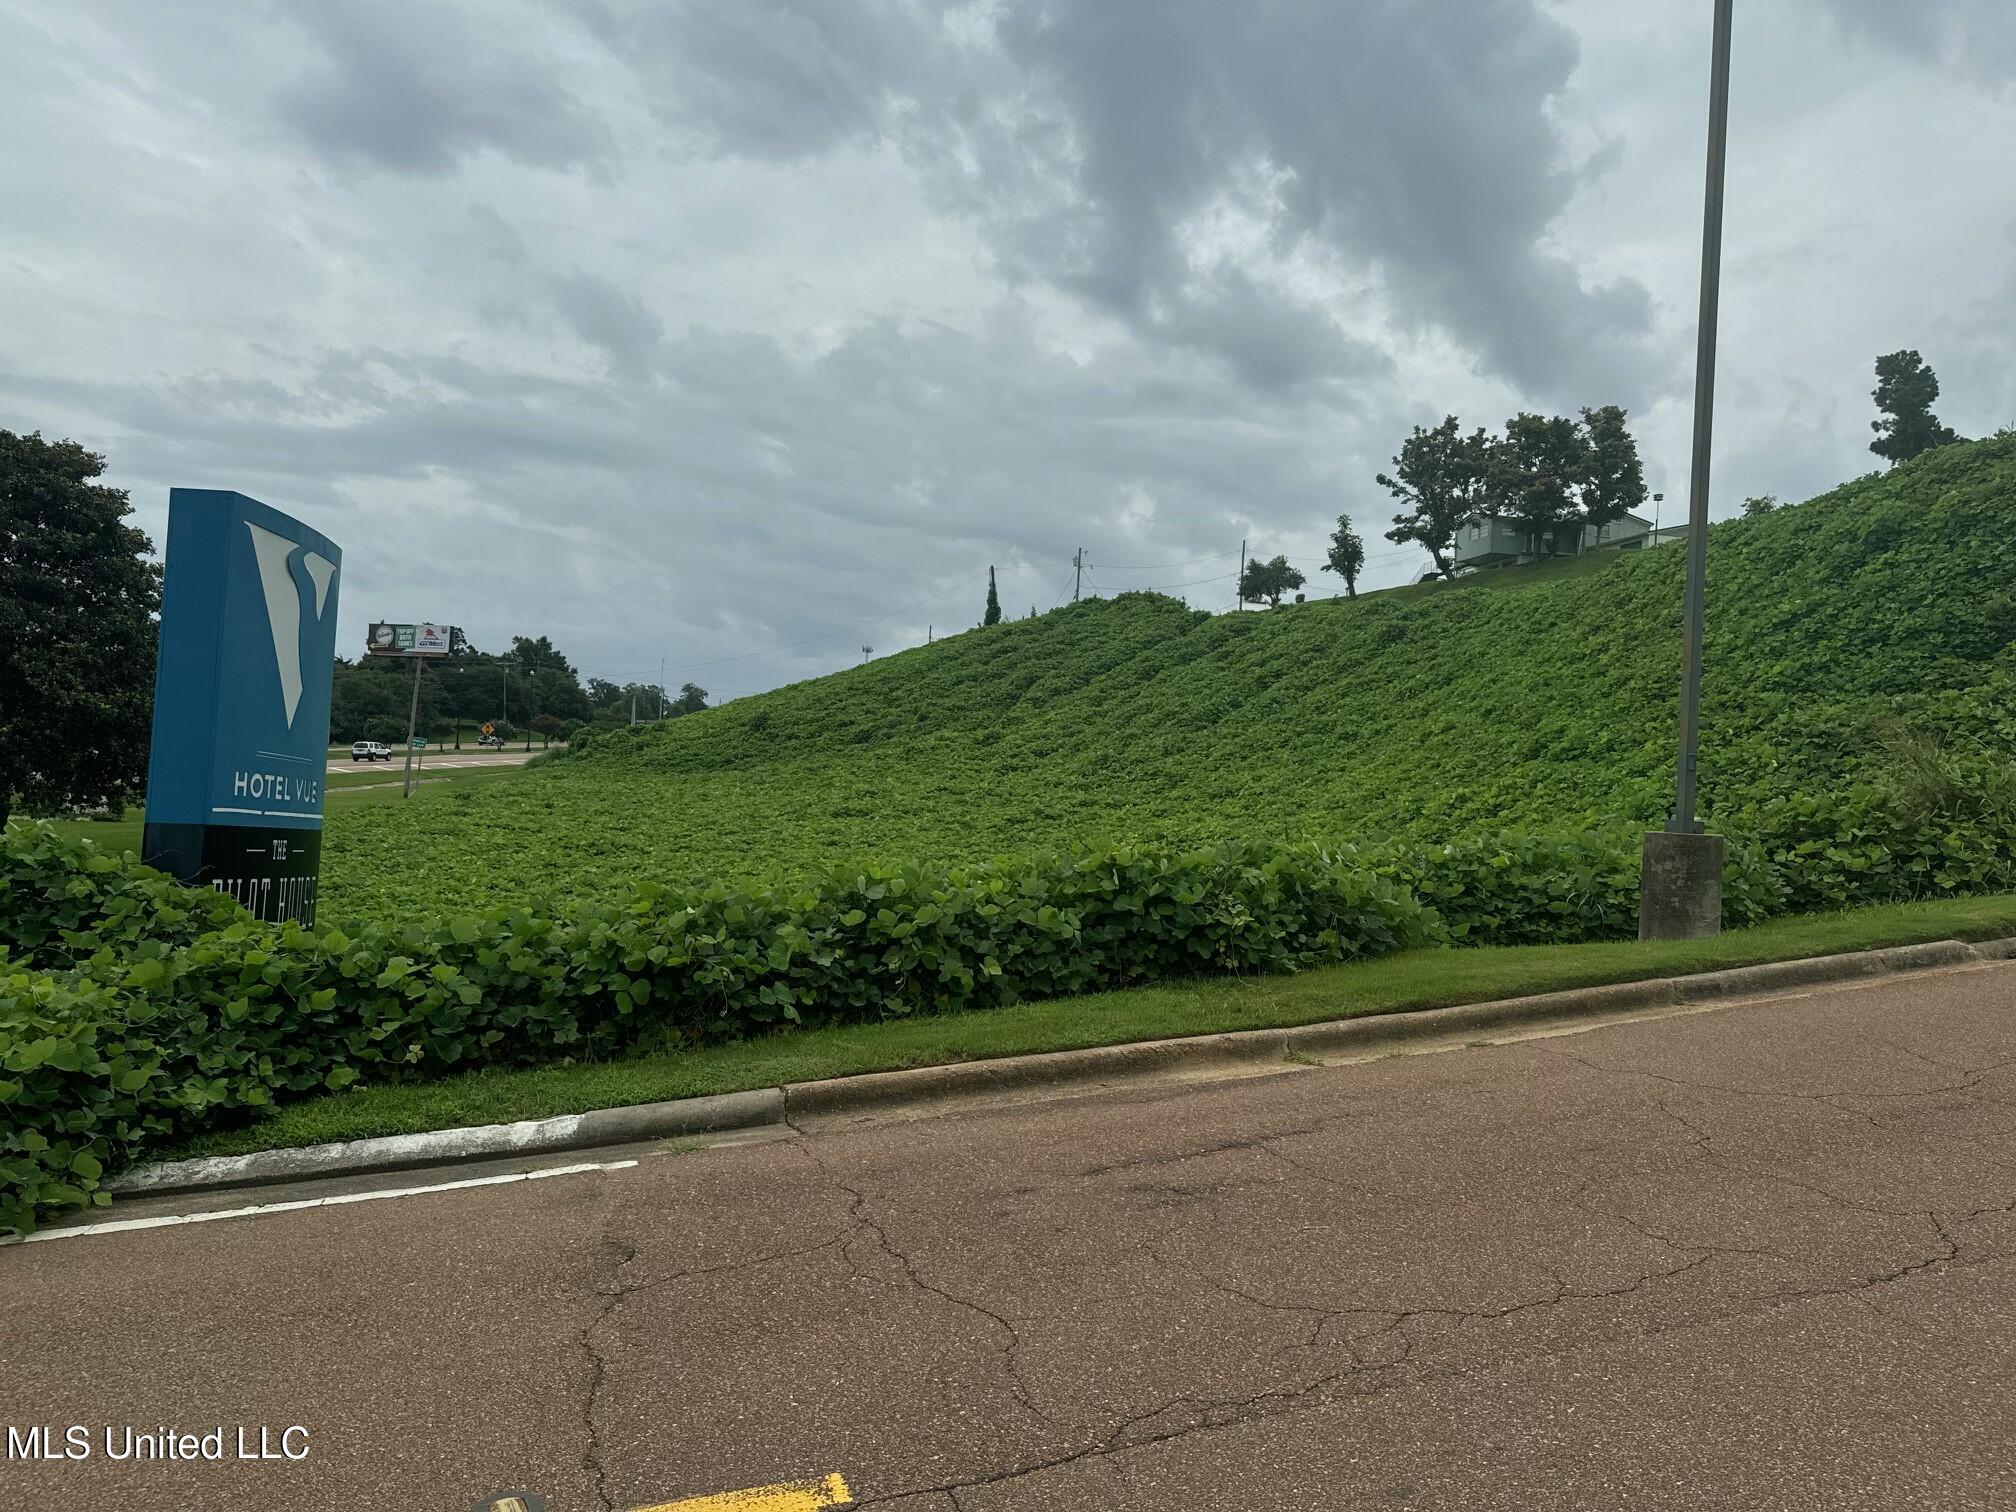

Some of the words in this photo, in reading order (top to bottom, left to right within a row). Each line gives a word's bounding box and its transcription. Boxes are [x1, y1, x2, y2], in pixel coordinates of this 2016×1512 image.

[234, 771, 291, 801] HOTEL
[296, 778, 318, 804] VUE
[272, 840, 288, 861] THE
[278, 876, 317, 928] HOUSE
